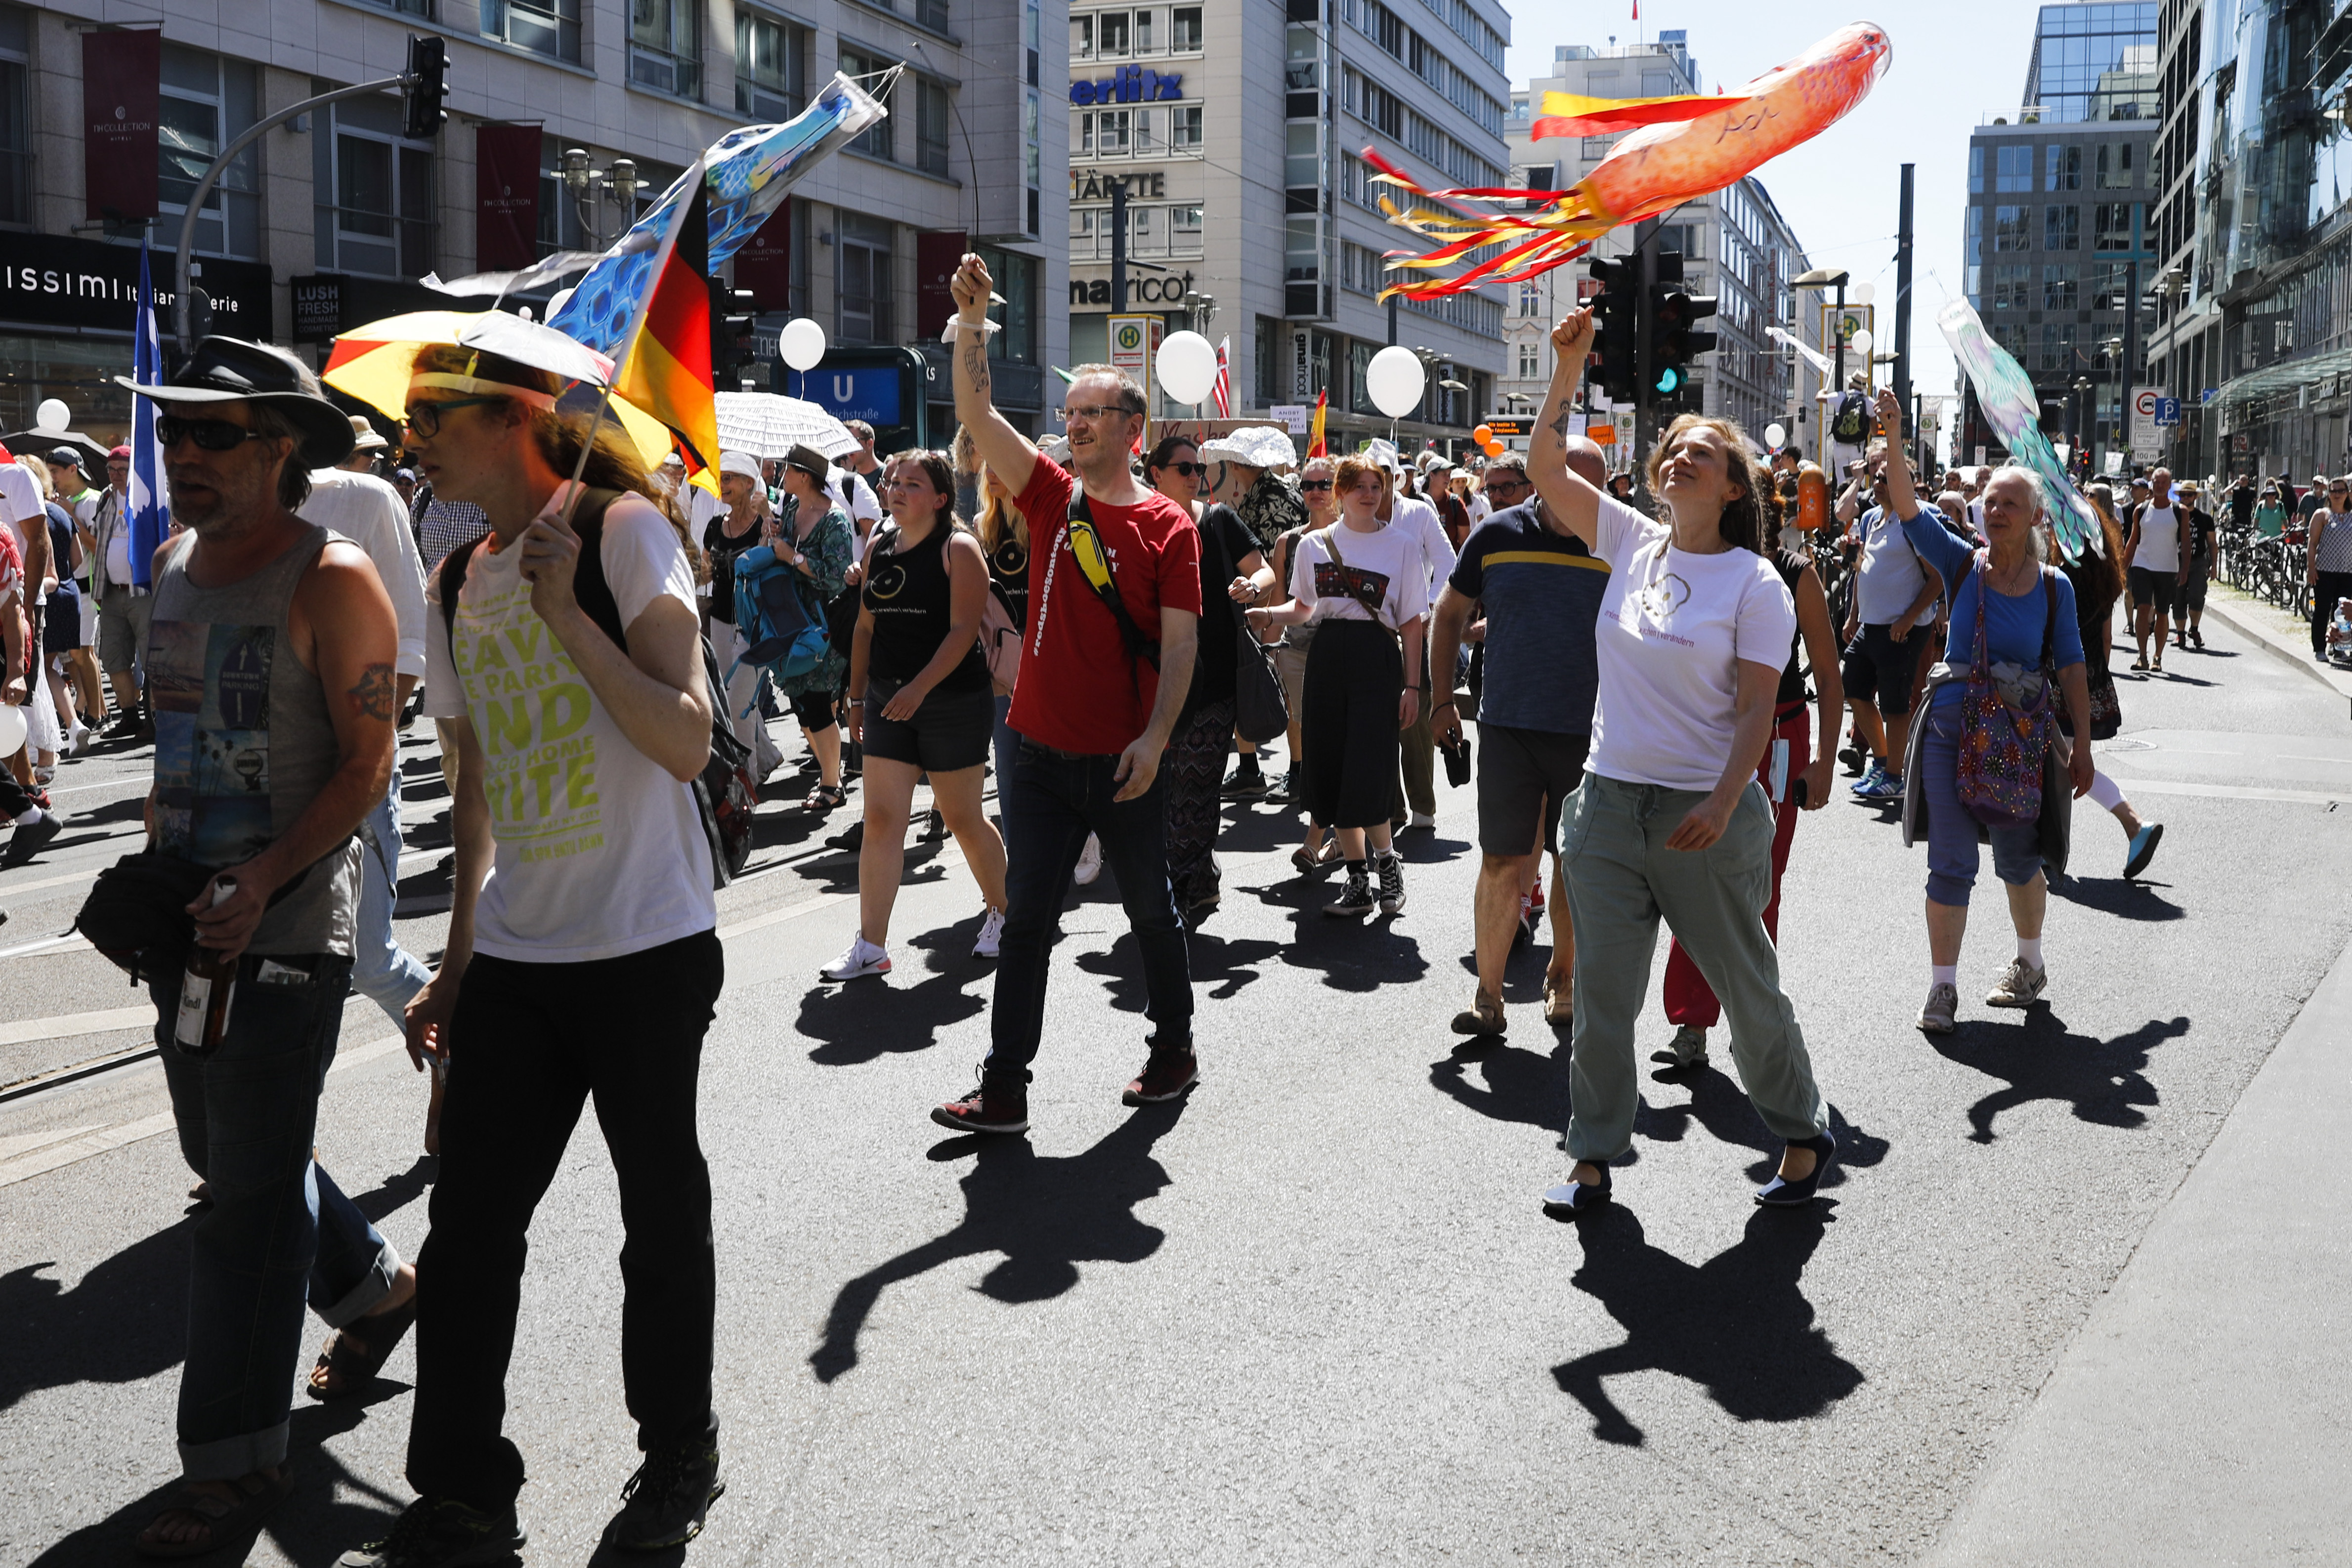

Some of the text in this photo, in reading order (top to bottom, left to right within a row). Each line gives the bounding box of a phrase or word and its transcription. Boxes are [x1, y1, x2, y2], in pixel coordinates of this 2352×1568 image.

[1069, 64, 1182, 105] erlitz
[104, 123, 150, 132] COLLECTION
[1082, 169, 1164, 198] ÄRZTE
[298, 286, 338, 301] LUSH
[1069, 270, 1194, 305] naricot
[127, 285, 174, 305] Itian
[210, 297, 238, 312] erie
[298, 301, 339, 315] FRESH
[299, 324, 339, 333] COSMETICS
[834, 375, 853, 402] U
[828, 407, 879, 420] richstraße
[2165, 404, 2174, 419] P
[1034, 527, 1067, 656] #redshoesontour
[1363, 583, 1375, 593] EA
[1661, 631, 1695, 648] verändern
[455, 621, 566, 676] EAV
[221, 681, 259, 691] PARKING
[467, 682, 592, 756] ND
[527, 734, 595, 767] HOME
[579, 809, 600, 820] CITY
[183, 994, 202, 1010] Kindl
